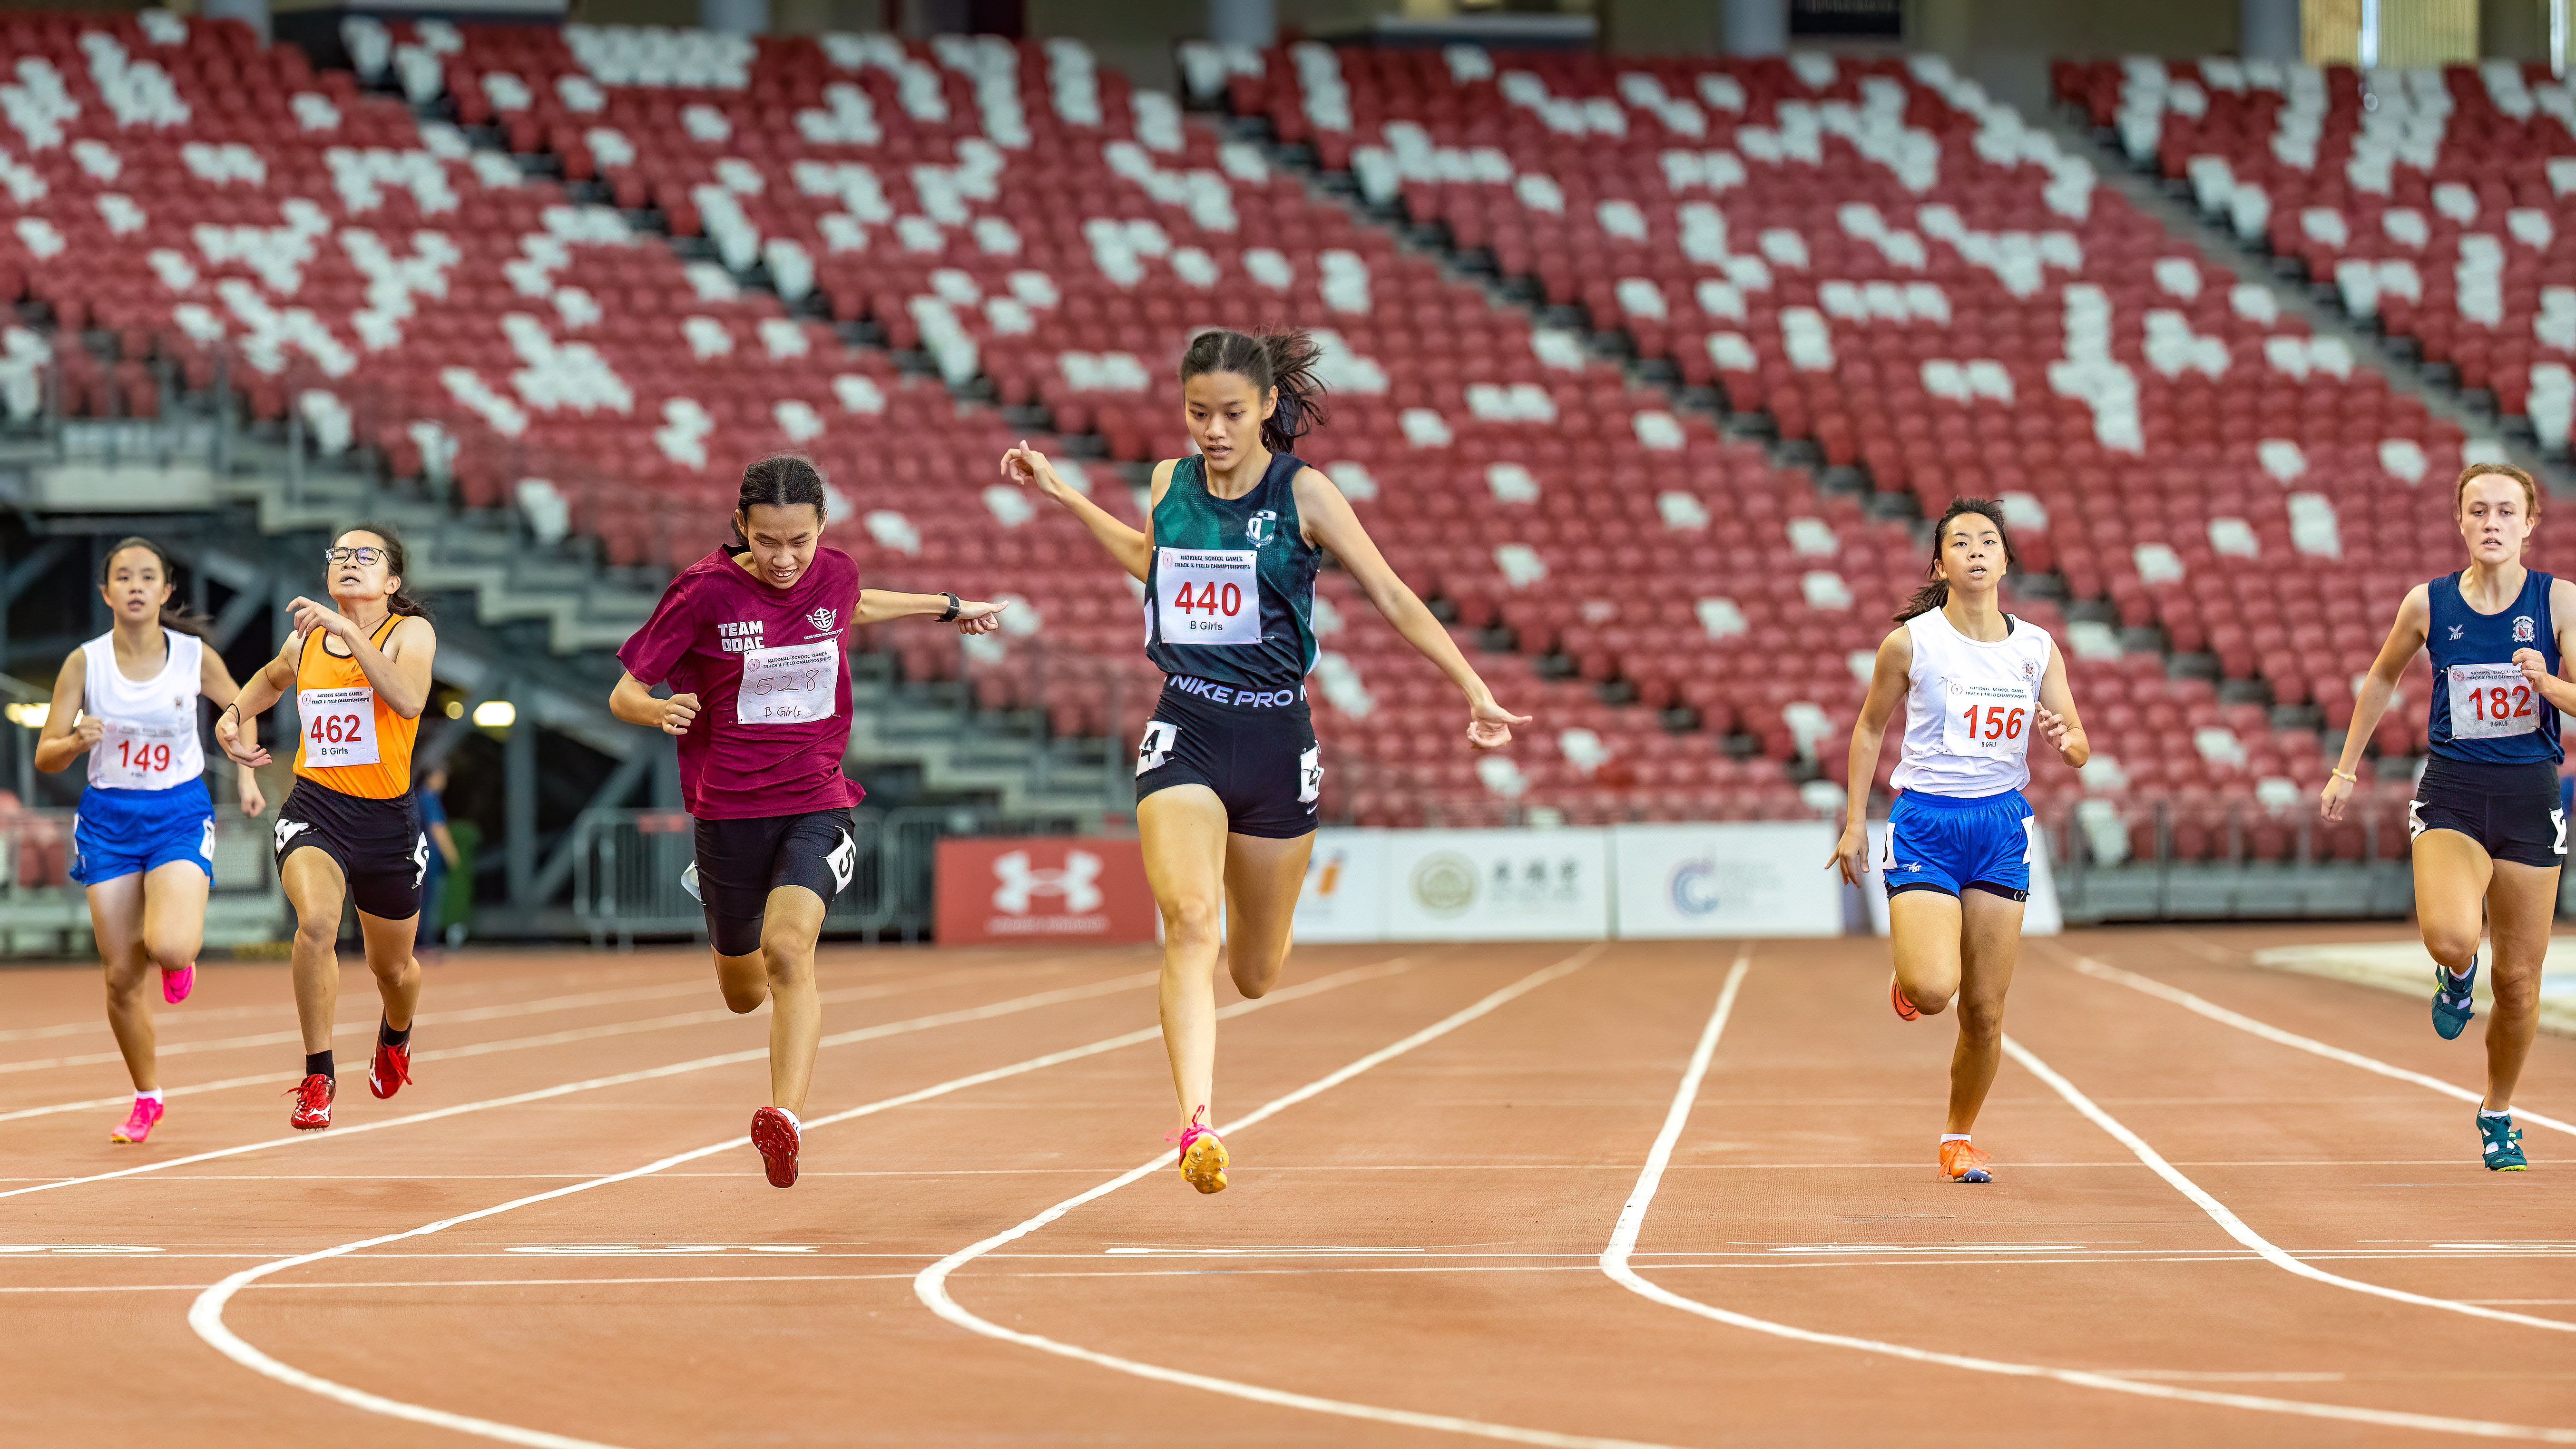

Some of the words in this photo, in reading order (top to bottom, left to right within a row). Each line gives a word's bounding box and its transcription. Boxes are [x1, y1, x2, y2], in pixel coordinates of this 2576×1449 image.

[1175, 581, 1241, 617] 440
[717, 620, 764, 637] TEAM
[1190, 621, 1196, 629] B
[1200, 621, 1223, 631] Girls
[722, 636, 765, 652] ODAC
[796, 656, 832, 665] CHAMPIONSHIPS
[754, 669, 820, 695] 528
[1169, 675, 1234, 704] NIKE
[1234, 689, 1293, 708] PRO
[765, 706, 772, 717] B
[777, 705, 801, 717] Girls
[2468, 685, 2532, 721] 182
[311, 714, 362, 743] 462
[1964, 705, 2025, 740] 156
[118, 739, 170, 772] 149
[330, 747, 349, 755] Girls
[1140, 729, 1160, 762] 4
[839, 844, 855, 878] 5
